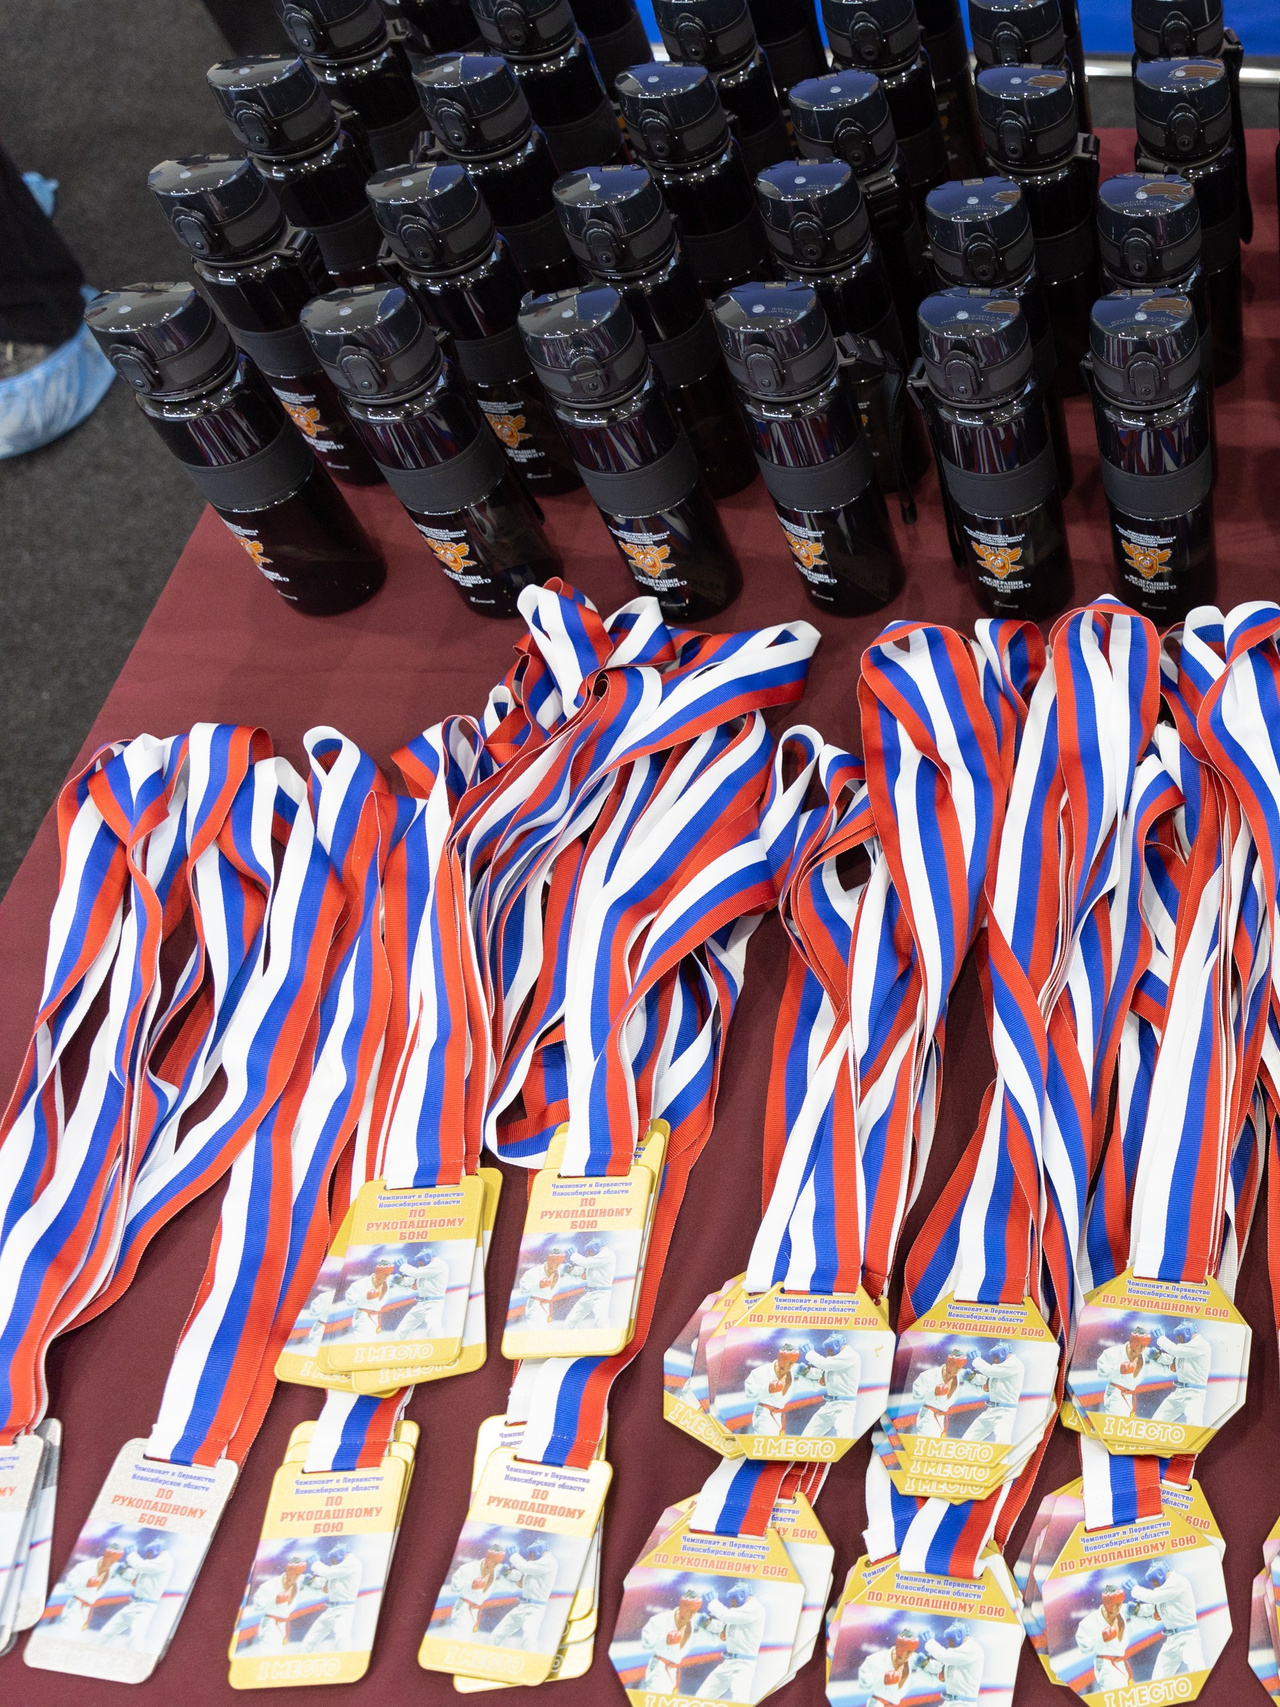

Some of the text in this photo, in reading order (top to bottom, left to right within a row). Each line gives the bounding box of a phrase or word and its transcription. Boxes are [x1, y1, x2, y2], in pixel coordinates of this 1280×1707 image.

[580, 1198, 596, 1206] ПО
[409, 1209, 425, 1218] ПО
[540, 1208, 632, 1219] РУКОПАШНОМУ
[366, 1218, 465, 1231] РУКОПАШНОМУ
[570, 1220, 597, 1229] БОЮ
[399, 1231, 428, 1240] БОЮ
[1102, 1295, 1229, 1318] ПО РУКОПАШНОМУ БОЮ
[749, 1314, 878, 1326] ПО РУКОПАШНОМУ БОЮ
[923, 1320, 1044, 1337] ПО РУКОПАШНОМУ БОЮ
[368, 1344, 434, 1362] МЕСТО
[1118, 1419, 1185, 1443] МЕСТО
[767, 1439, 835, 1458] МЕСТО
[927, 1440, 993, 1462] МЕСТО
[924, 1462, 989, 1481] МЕСТО
[156, 1489, 173, 1499] ПО
[326, 1496, 343, 1506] ПО
[531, 1489, 548, 1499] ПО
[112, 1495, 207, 1519] РУКОПАШНОМУ
[280, 1507, 383, 1522] РУКОПАШНОМУ
[487, 1496, 585, 1519] РУКОПАШНОМУ
[138, 1514, 167, 1527] БОЮ
[313, 1522, 343, 1533] БОЮ
[516, 1515, 546, 1528] БОЮ
[1186, 1516, 1210, 1530] БОЮ
[792, 1528, 818, 1539] БОЮ
[1081, 1532, 1120, 1544] Чемпионат
[1129, 1521, 1171, 1534] Первенство
[1060, 1535, 1197, 1572] ПО РУКОПАШНОМУ БОЮ
[653, 1553, 788, 1577] ПО РУКОПАШНОМУ БОЮ
[895, 1574, 934, 1584] Чемпионат
[944, 1579, 985, 1591] Первенство
[867, 1591, 1005, 1617] ПО РУКОПАШНОМУ БОЮ
[1117, 1678, 1191, 1706] МЕСТО
